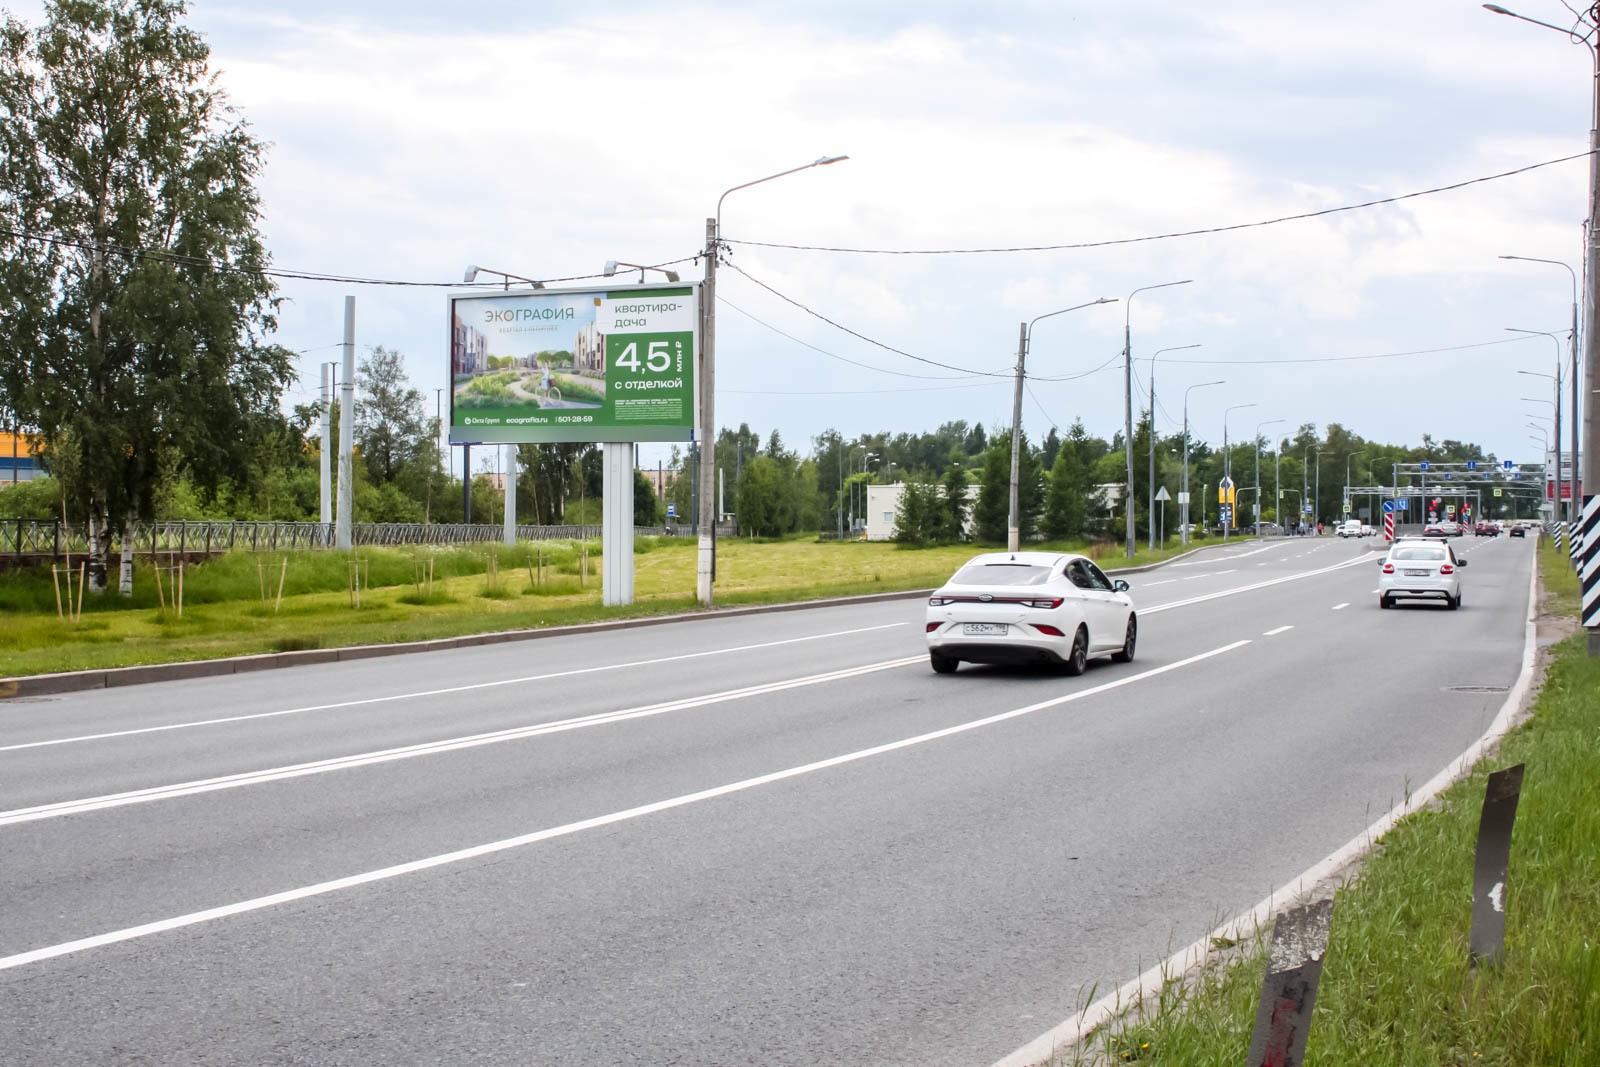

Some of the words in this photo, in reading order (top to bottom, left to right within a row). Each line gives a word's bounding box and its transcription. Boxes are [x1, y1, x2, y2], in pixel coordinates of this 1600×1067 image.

[485, 307, 575, 323] ЭКОГРАФИЯ
[614, 303, 683, 315] квартира-
[614, 318, 647, 329] дача
[615, 341, 671, 375] 4,5
[614, 381, 622, 390] с
[624, 377, 683, 391] отделкой
